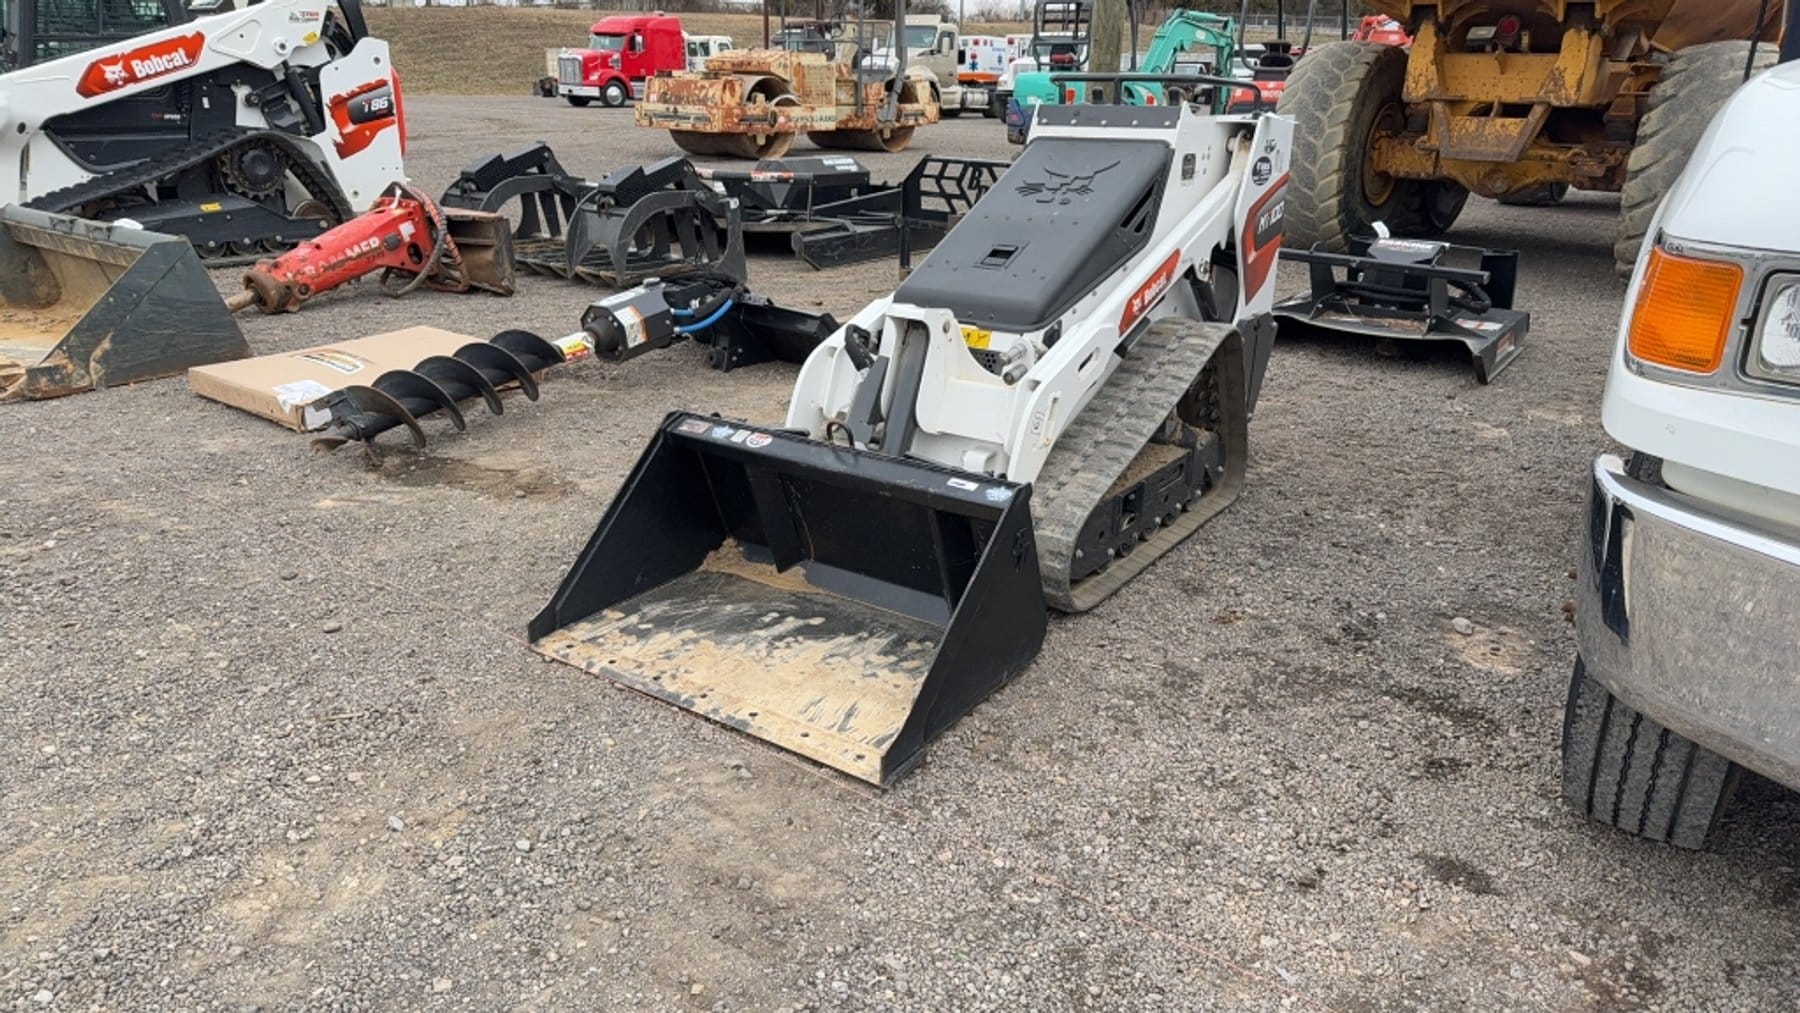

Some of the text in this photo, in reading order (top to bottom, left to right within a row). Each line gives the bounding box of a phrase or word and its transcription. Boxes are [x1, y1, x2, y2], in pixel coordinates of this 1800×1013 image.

[130, 48, 188, 78] Bobcat
[362, 97, 388, 113] T86
[1144, 271, 1167, 306] Bobcat
